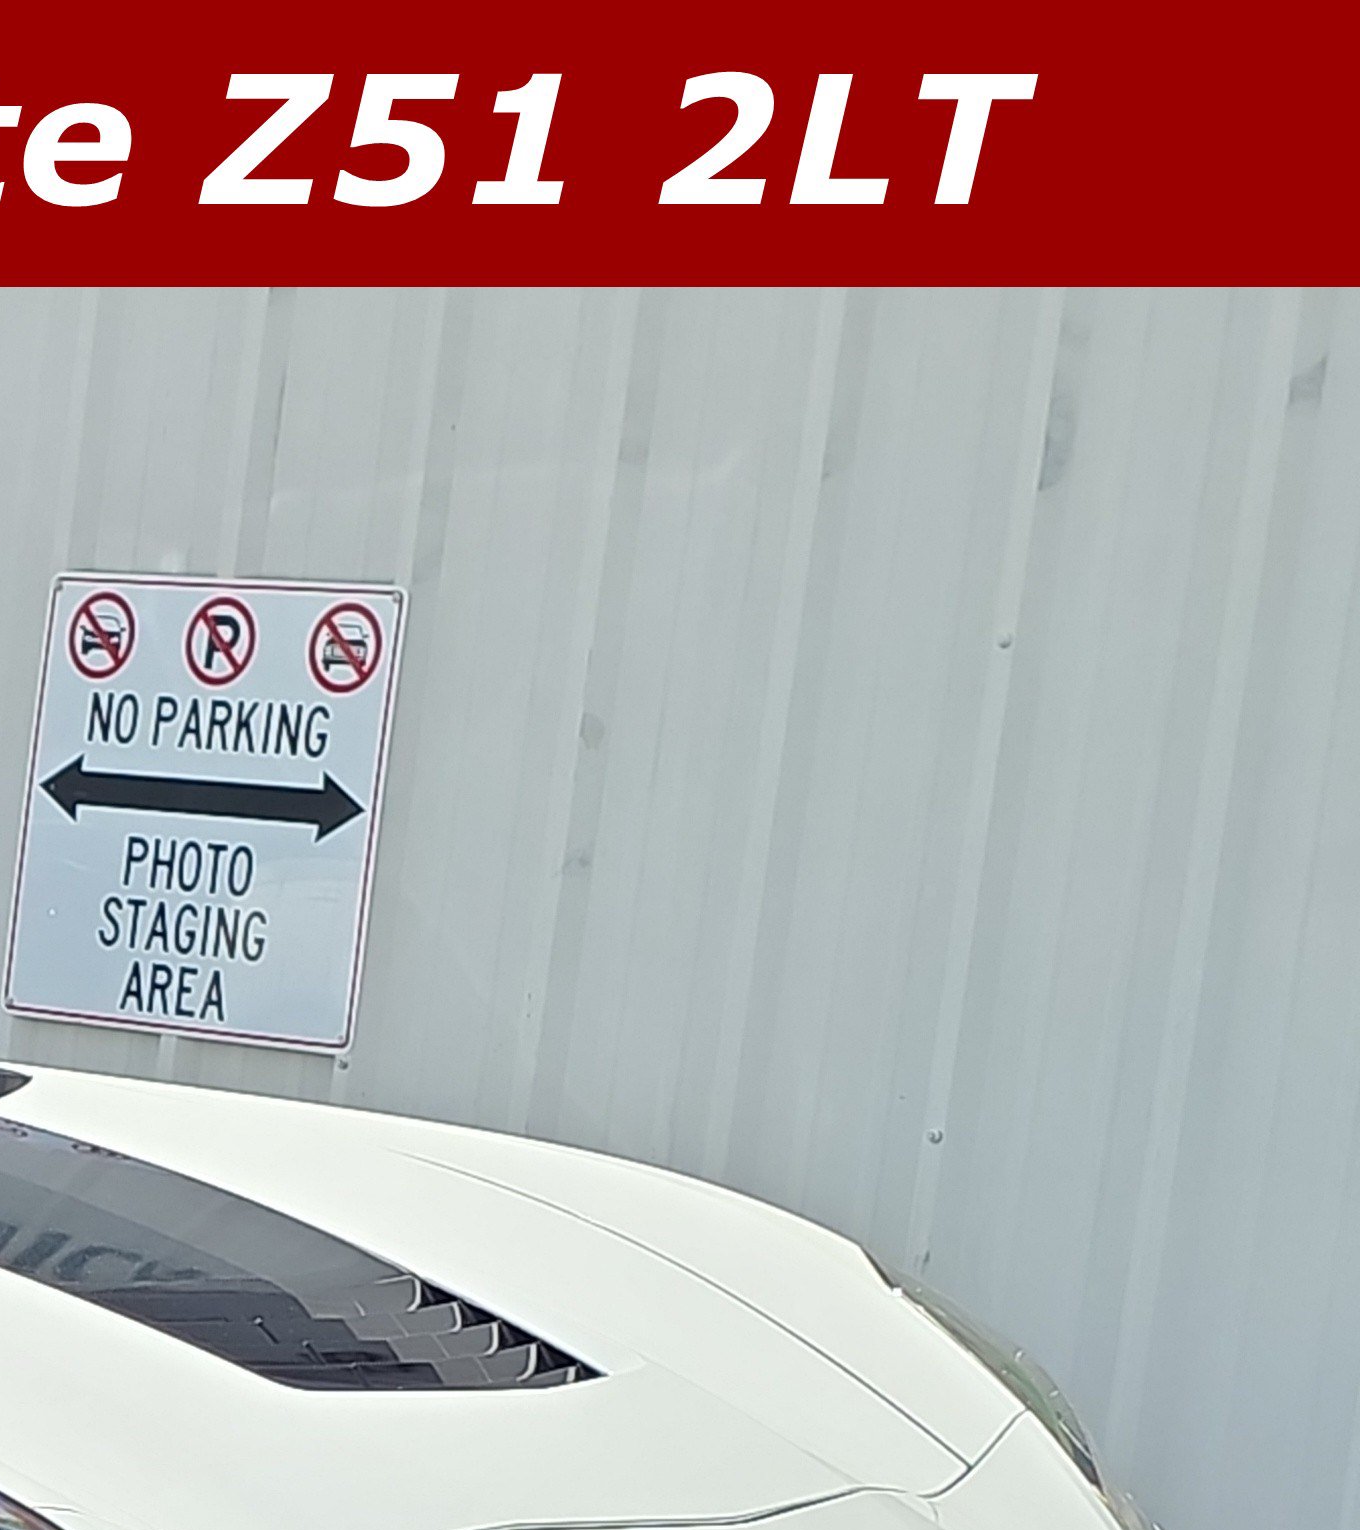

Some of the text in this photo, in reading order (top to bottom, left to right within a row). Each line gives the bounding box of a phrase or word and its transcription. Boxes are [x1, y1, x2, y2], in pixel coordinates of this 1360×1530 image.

[86, 692, 331, 758] NO PARKING
[122, 836, 254, 897] PHOTO
[97, 897, 268, 962] STAGING
[119, 961, 226, 1022] AREA
